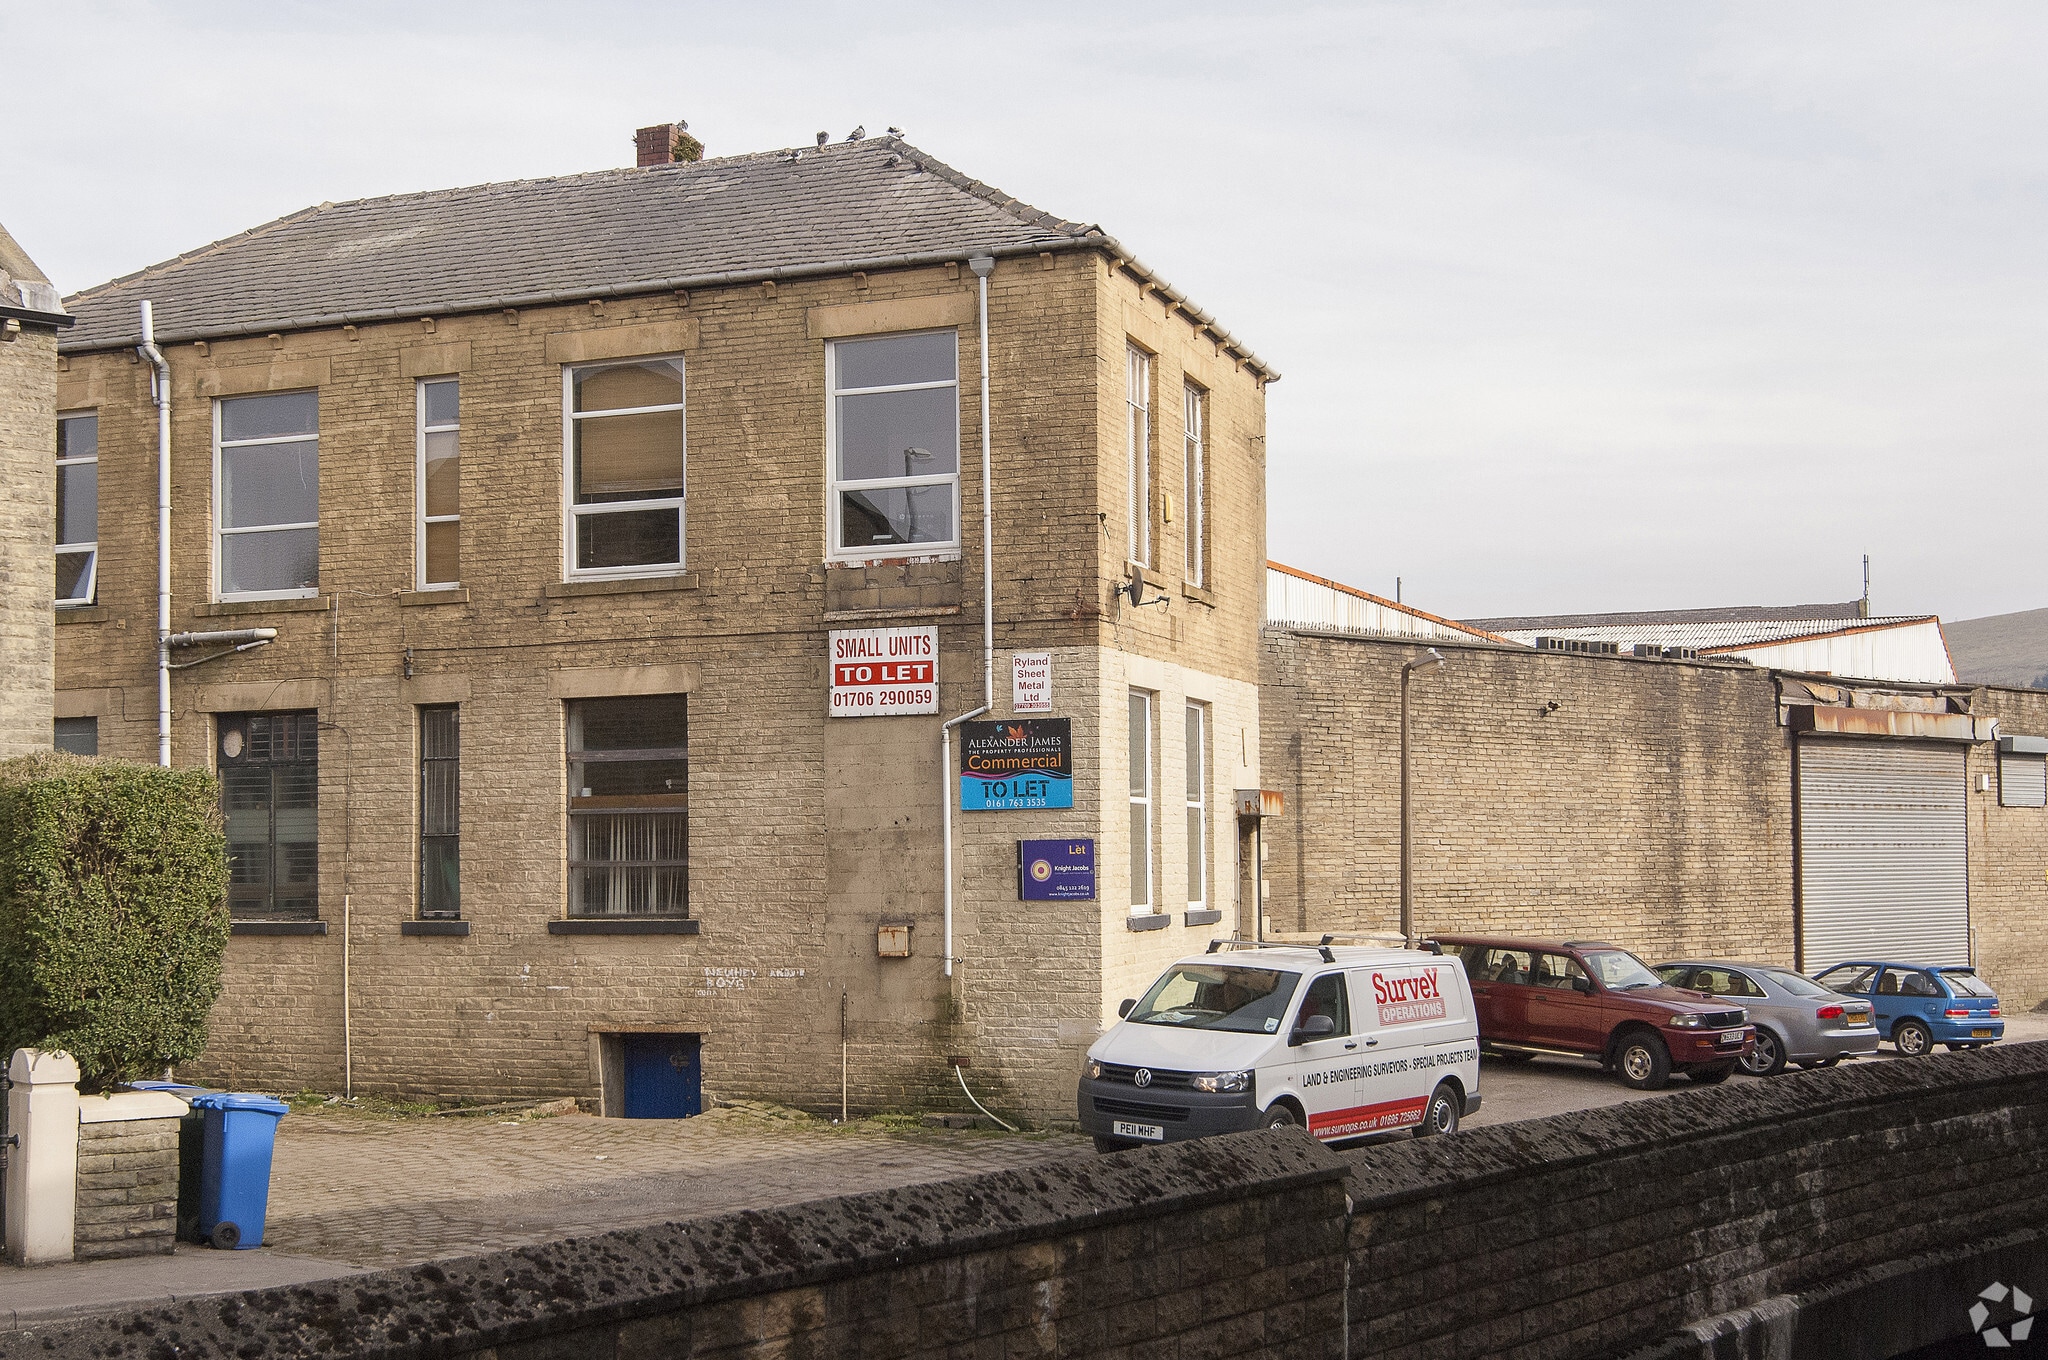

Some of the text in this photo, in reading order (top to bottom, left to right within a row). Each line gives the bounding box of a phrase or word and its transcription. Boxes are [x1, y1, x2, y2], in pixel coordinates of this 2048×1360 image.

[836, 635, 931, 659] SMALL UNITS
[1014, 657, 1048, 668] Ryland
[839, 664, 928, 682] TO LET
[1017, 669, 1045, 678] Sheet
[1018, 681, 1044, 690] Metal
[833, 689, 932, 707] 01706 290059
[1023, 693, 1040, 701] Ltd
[968, 736, 1061, 749] ALEXANDER JAMES
[968, 753, 1062, 770] Commercial
[981, 780, 1050, 798] TO LET
[986, 798, 1046, 808] 0161 763 3535
[1069, 845, 1086, 855] Let
[1382, 1002, 1443, 1022] OPERATIONS
[1302, 1072, 1322, 1088] LAND
[1322, 1071, 1329, 1084] &
[1330, 1064, 1372, 1083] ENGINEERING
[1373, 1059, 1408, 1077] SURVEYORS
[1412, 1055, 1436, 1070] SPECIAL
[1436, 1051, 1464, 1066] PROJECTS
[1464, 1048, 1478, 1062] TEAM
[1313, 1116, 1378, 1137] www.survops.co.uk
